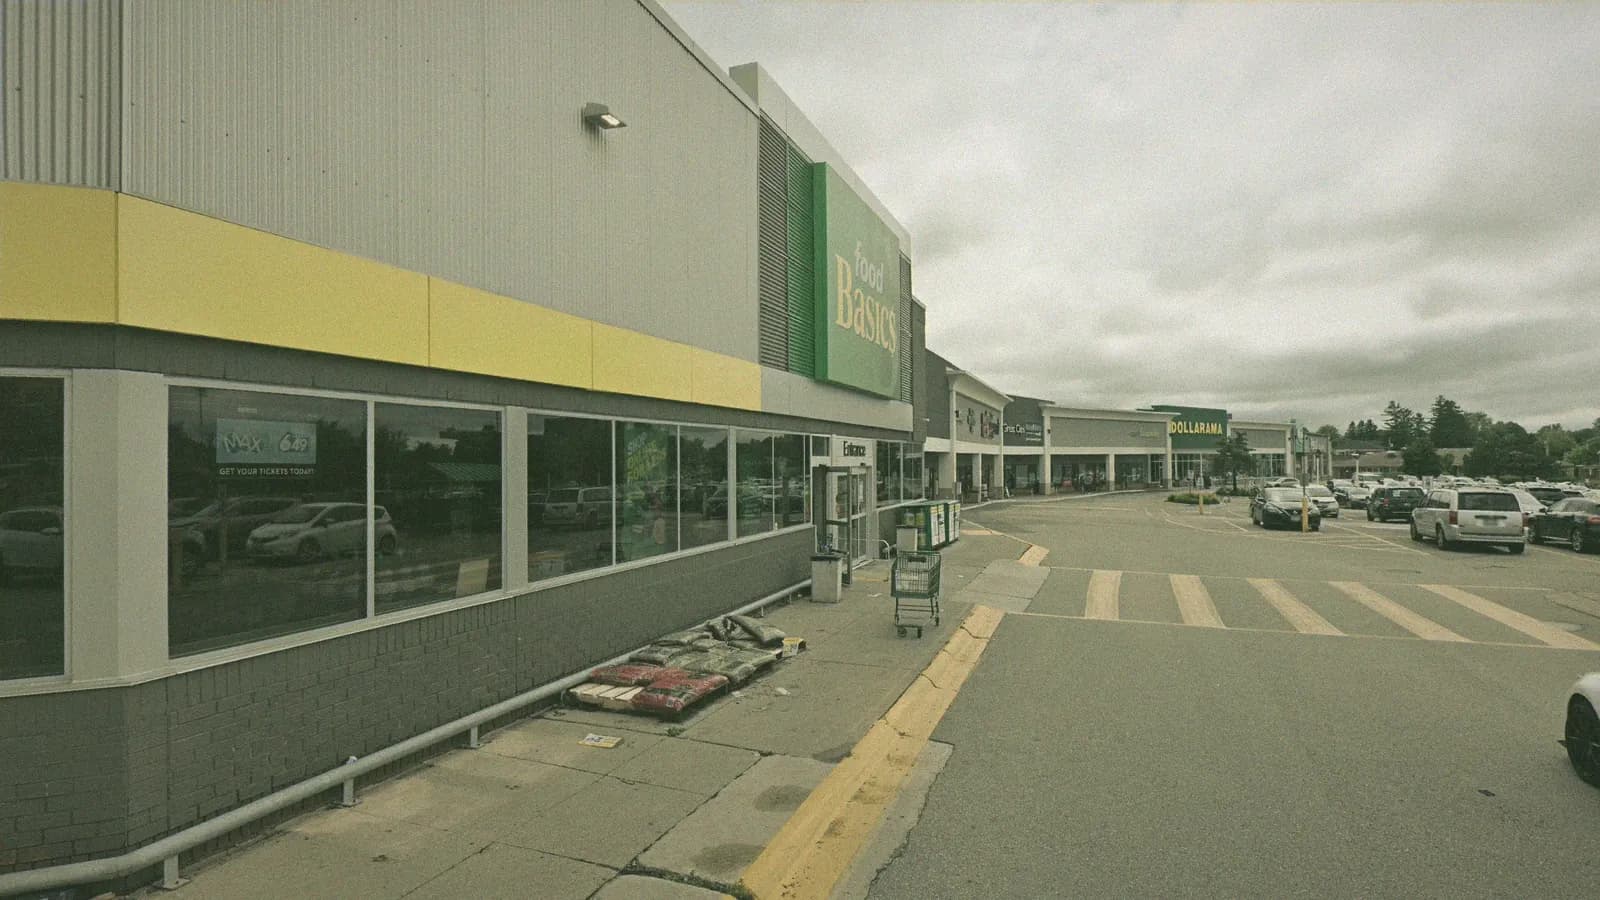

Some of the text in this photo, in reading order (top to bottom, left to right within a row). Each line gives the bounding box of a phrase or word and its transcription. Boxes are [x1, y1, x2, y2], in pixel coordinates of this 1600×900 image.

[854, 240, 885, 295] food
[835, 253, 896, 356] Basics
[1170, 420, 1223, 435] DOLLARAMA
[222, 431, 262, 454] MAX
[843, 440, 866, 457] Entrance
[219, 467, 236, 476] GET
[237, 467, 258, 476] YOUR
[260, 467, 289, 476] TICKETS
